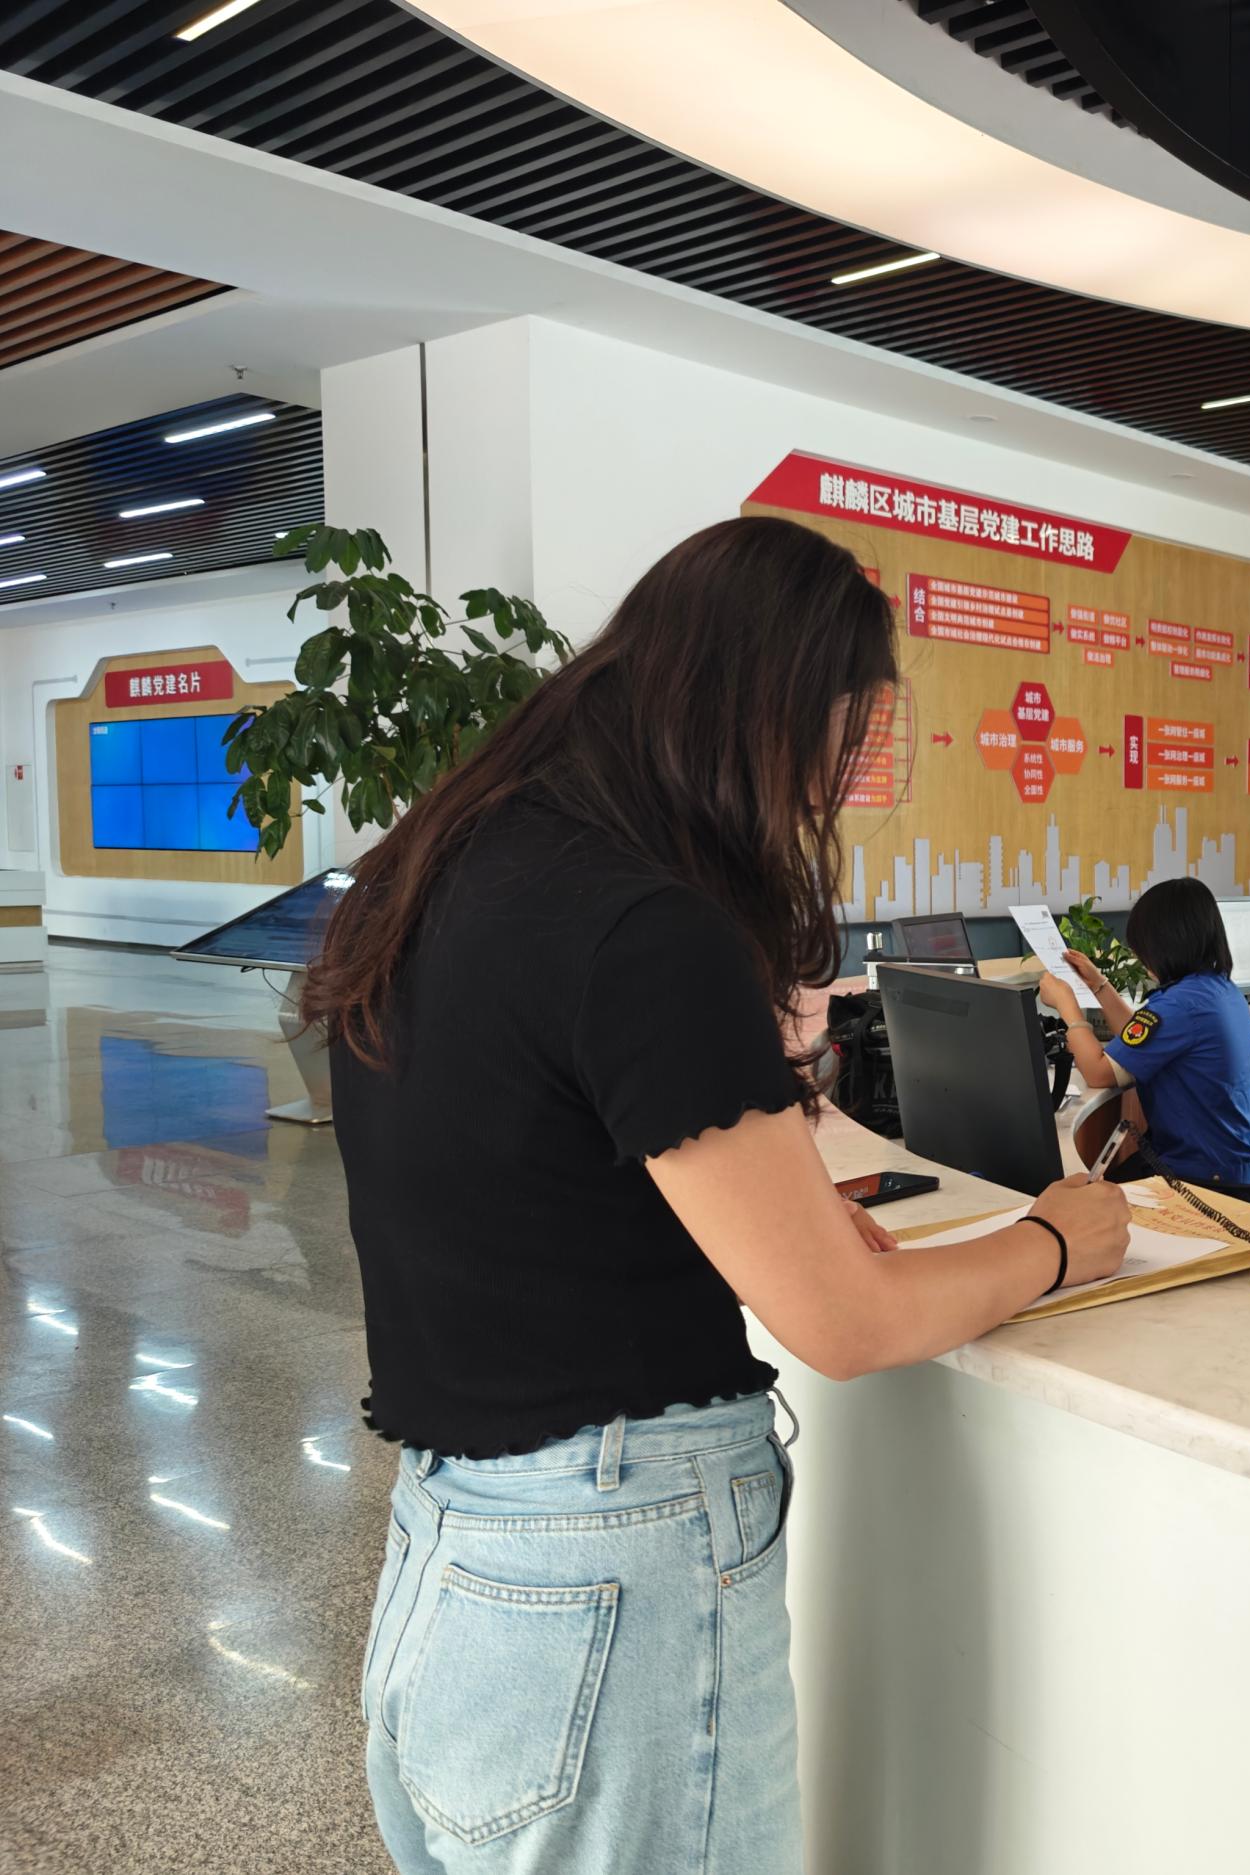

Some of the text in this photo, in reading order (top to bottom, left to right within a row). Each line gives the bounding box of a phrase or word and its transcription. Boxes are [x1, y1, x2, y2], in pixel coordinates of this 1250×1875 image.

[819, 473, 1095, 561] 麒麟区城市基层党建工作思路
[913, 588, 926, 623] 结合
[129, 671, 201, 698] 麒麟党建名片
[1025, 691, 1041, 704] 城市
[1018, 706, 1050, 722] 基层党建
[980, 732, 1017, 748] 城市治理
[1050, 738, 1084, 753] 城市服务
[1129, 736, 1139, 764] 实现
